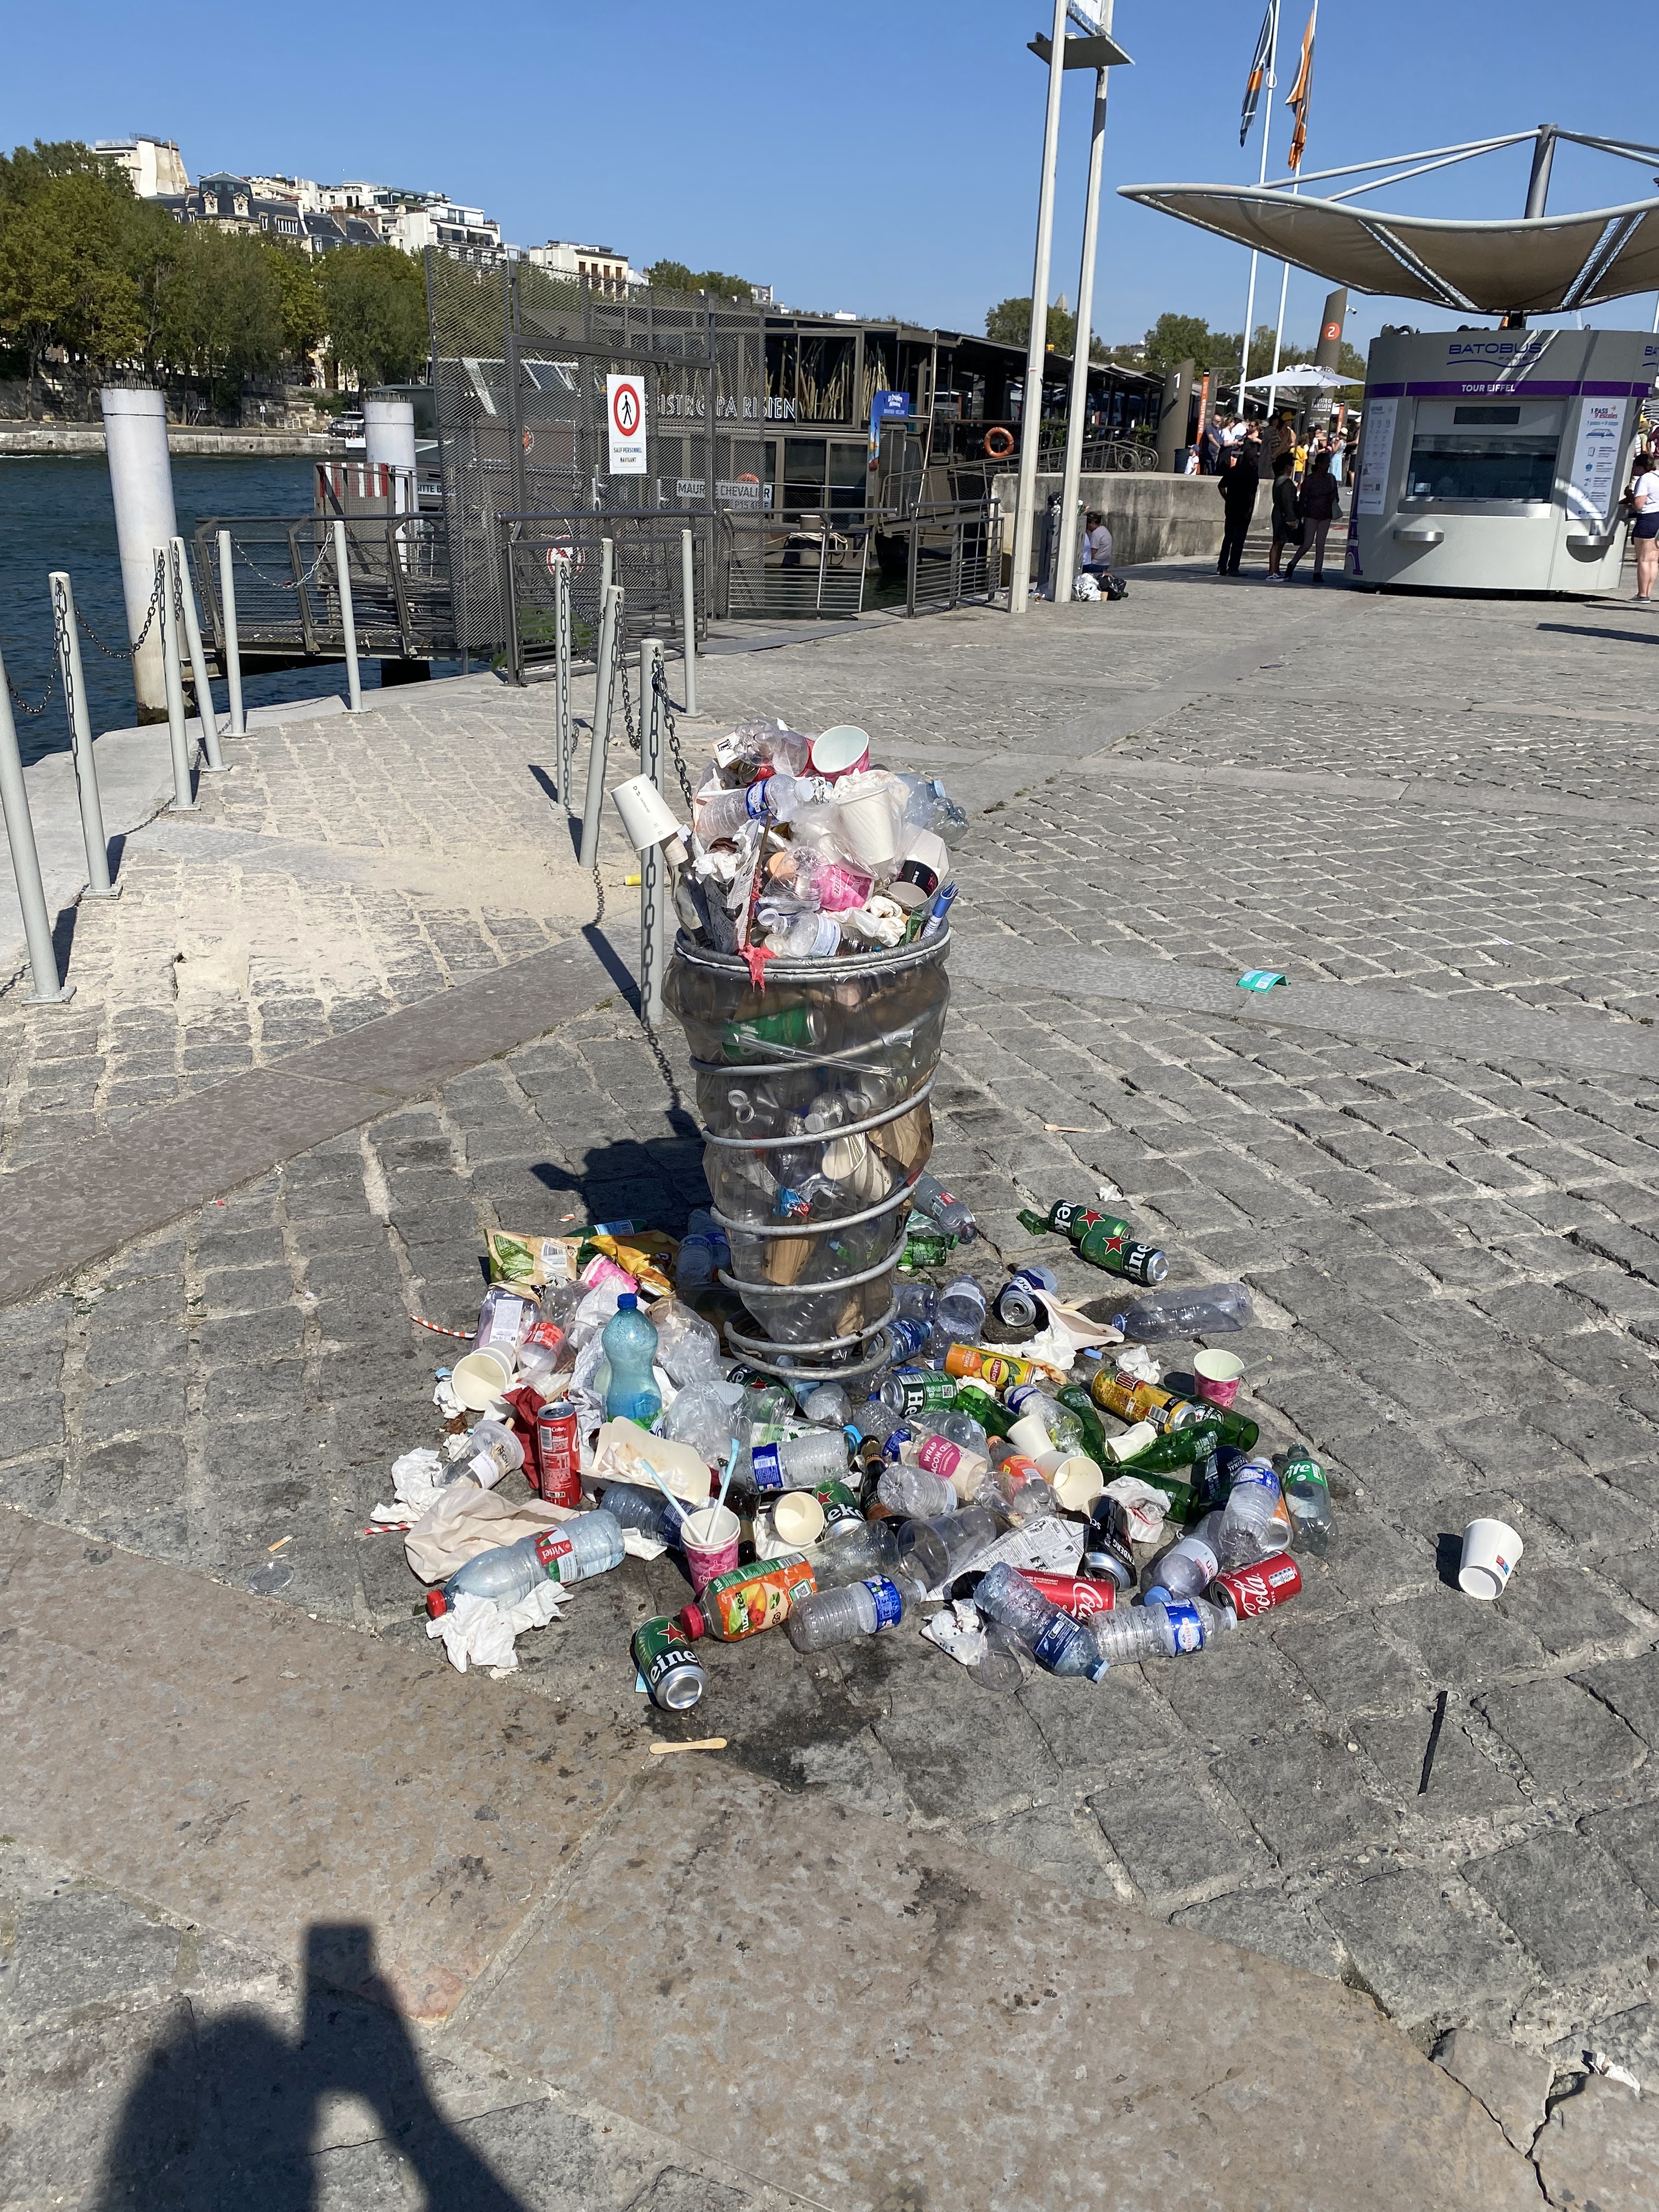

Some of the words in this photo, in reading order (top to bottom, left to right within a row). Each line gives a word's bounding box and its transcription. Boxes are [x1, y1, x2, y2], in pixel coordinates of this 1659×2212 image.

[1328, 326, 1336, 337] 2
[1448, 343, 1543, 354] BATOBUS
[1173, 373, 1181, 388] 1
[991, 1360, 1001, 1382] Lipton
[923, 1442, 938, 1462] WRAP
[541, 1544, 565, 1560] Vittel
[713, 1579, 725, 1593] fuze
[735, 1591, 749, 1634] fuzetea
